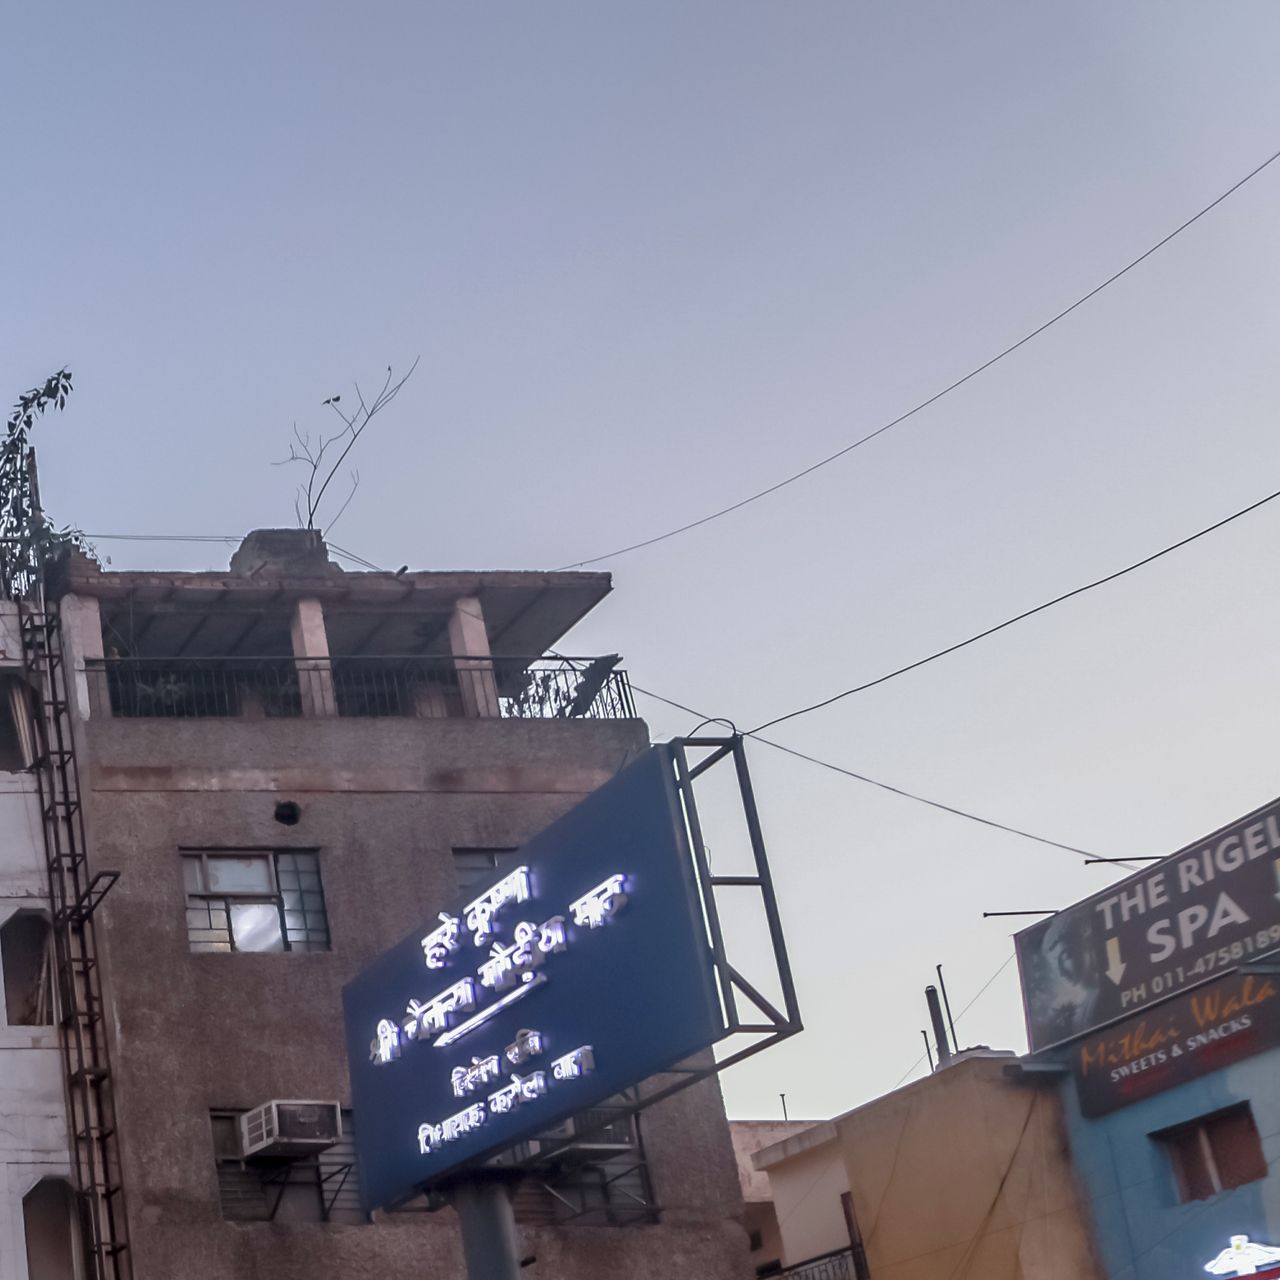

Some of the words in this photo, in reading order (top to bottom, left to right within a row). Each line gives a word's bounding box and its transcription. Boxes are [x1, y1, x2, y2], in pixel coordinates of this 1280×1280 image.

[1096, 873, 1166, 930] THE
[1178, 815, 1280, 894] RIGEL
[1146, 892, 1250, 963] SPA
[1122, 985, 1147, 1007] PH
[1081, 1017, 1181, 1077] Mithai
[1111, 1052, 1165, 1082] SWEETS
[1171, 1043, 1183, 1057] &
[1189, 1015, 1252, 1050] SNACKS
